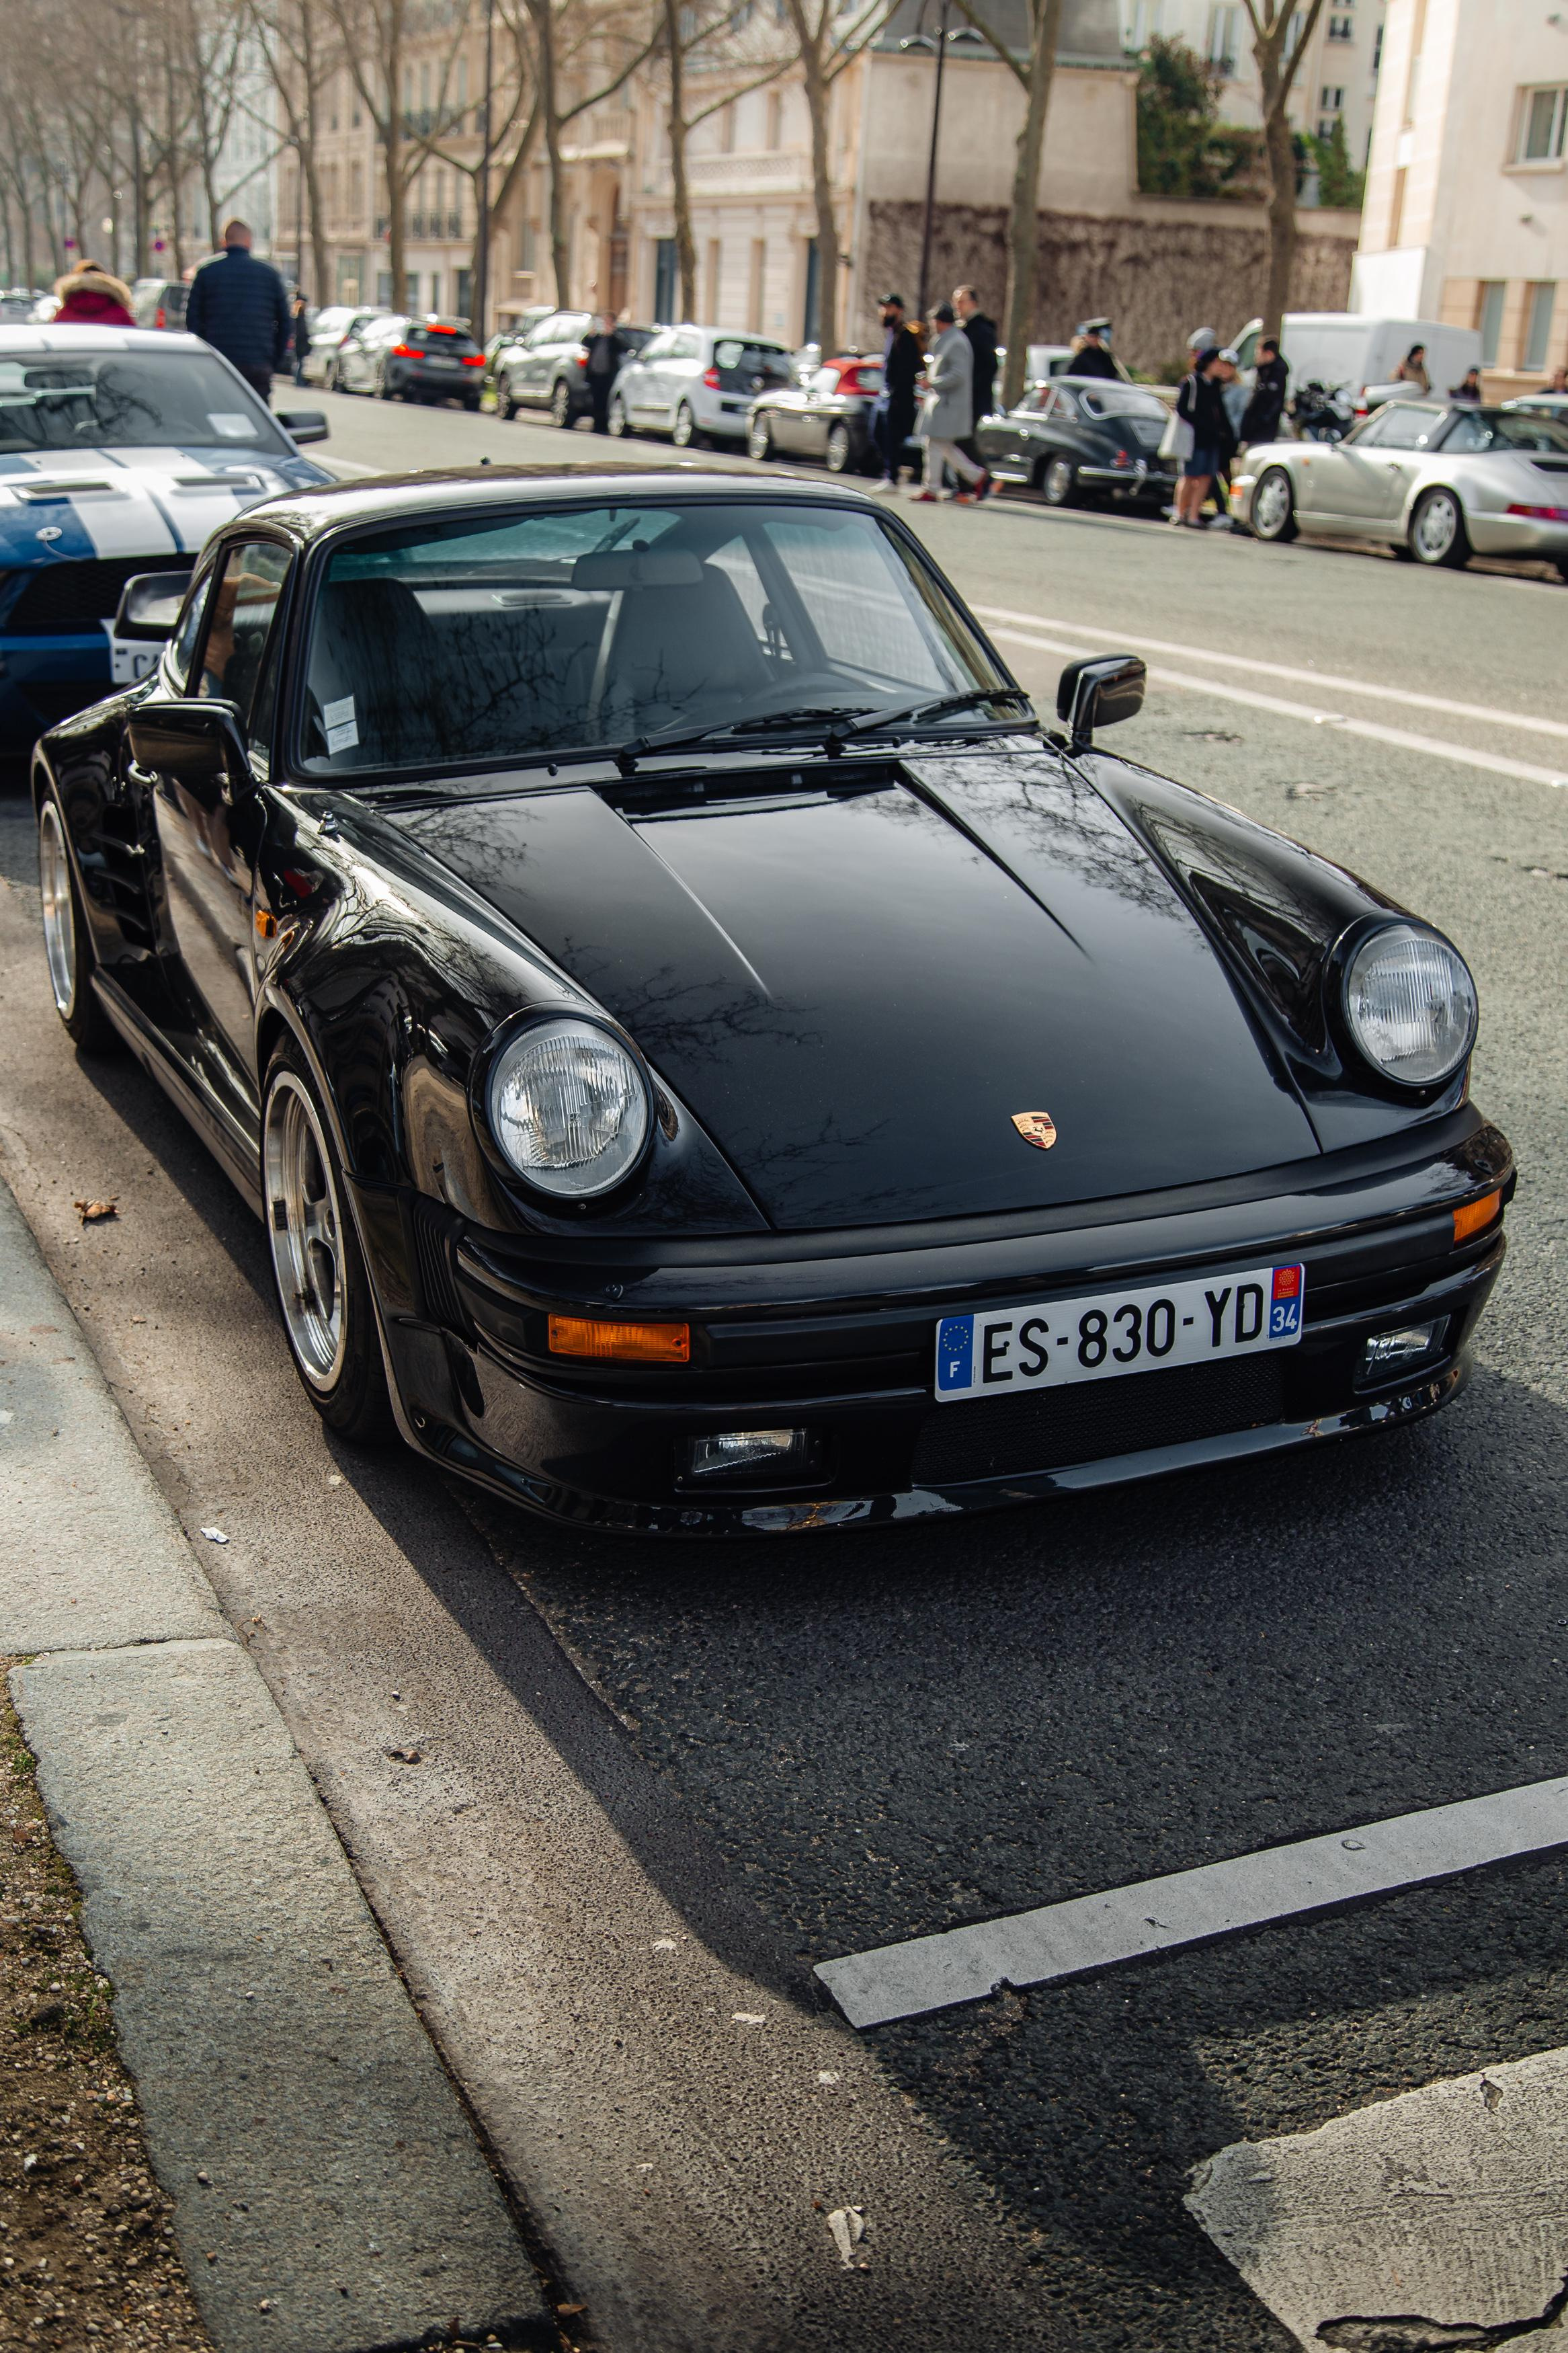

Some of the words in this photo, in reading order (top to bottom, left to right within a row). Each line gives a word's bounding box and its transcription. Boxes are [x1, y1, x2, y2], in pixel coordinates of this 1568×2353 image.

[1272, 1304, 1298, 1332] 34
[983, 1283, 1264, 1384] ES-830-YD
[949, 1361, 960, 1378] F
